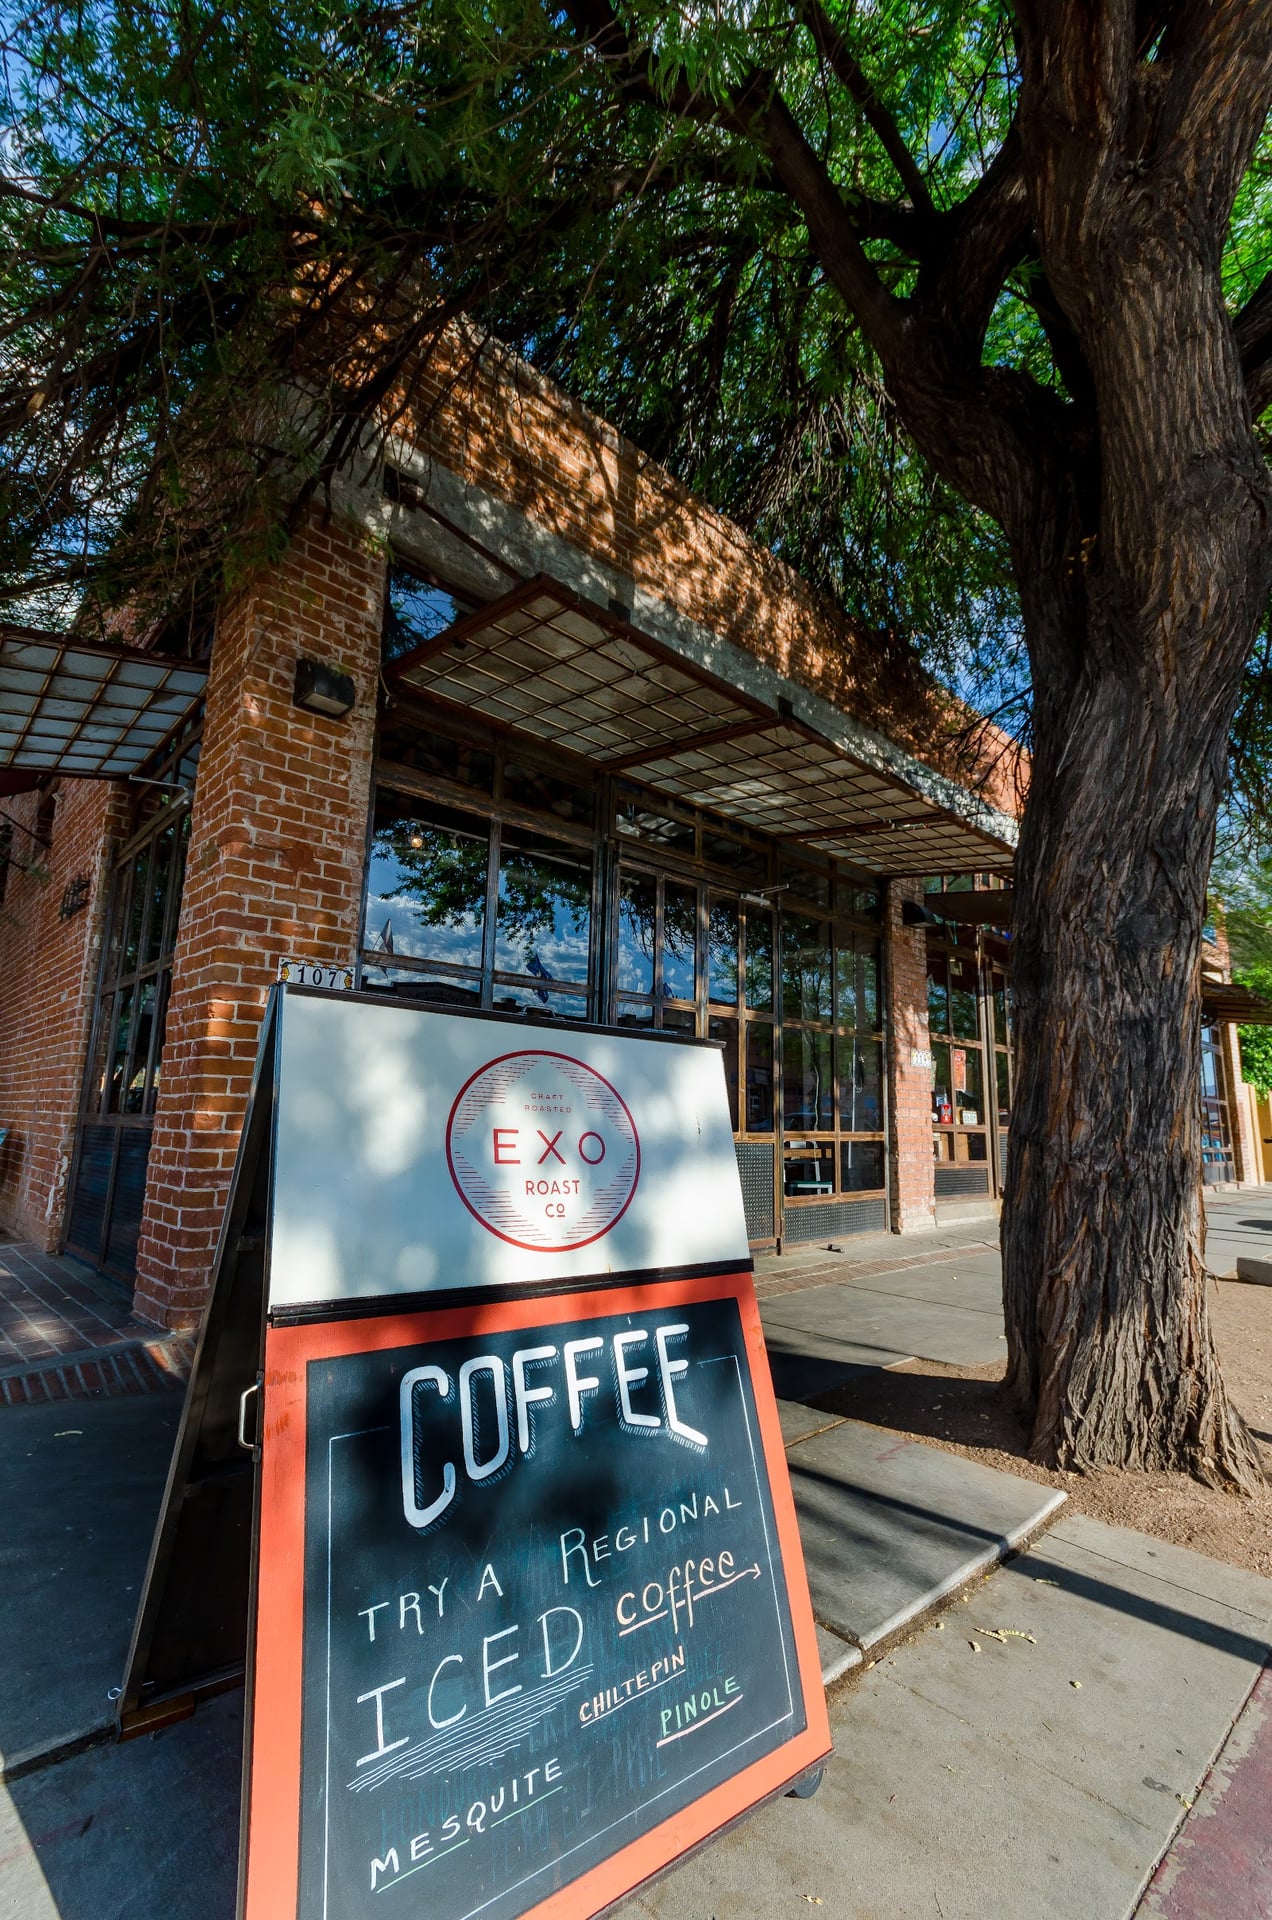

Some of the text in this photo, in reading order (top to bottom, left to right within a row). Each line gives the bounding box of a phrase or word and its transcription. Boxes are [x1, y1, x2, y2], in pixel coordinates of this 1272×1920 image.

[298, 966, 337, 987] 107
[524, 1104, 572, 1113] ROASTED
[493, 1128, 606, 1165] EXO
[525, 1180, 580, 1195] ROAST
[400, 1322, 709, 1531] COFFEE
[358, 1488, 743, 1643] TRY A REGIONAL
[356, 1550, 736, 1767] ICED coffee
[579, 1646, 686, 1722] CHILTEPIN
[660, 1676, 742, 1738] PINOLE
[370, 1758, 564, 1878] MESQUITE
